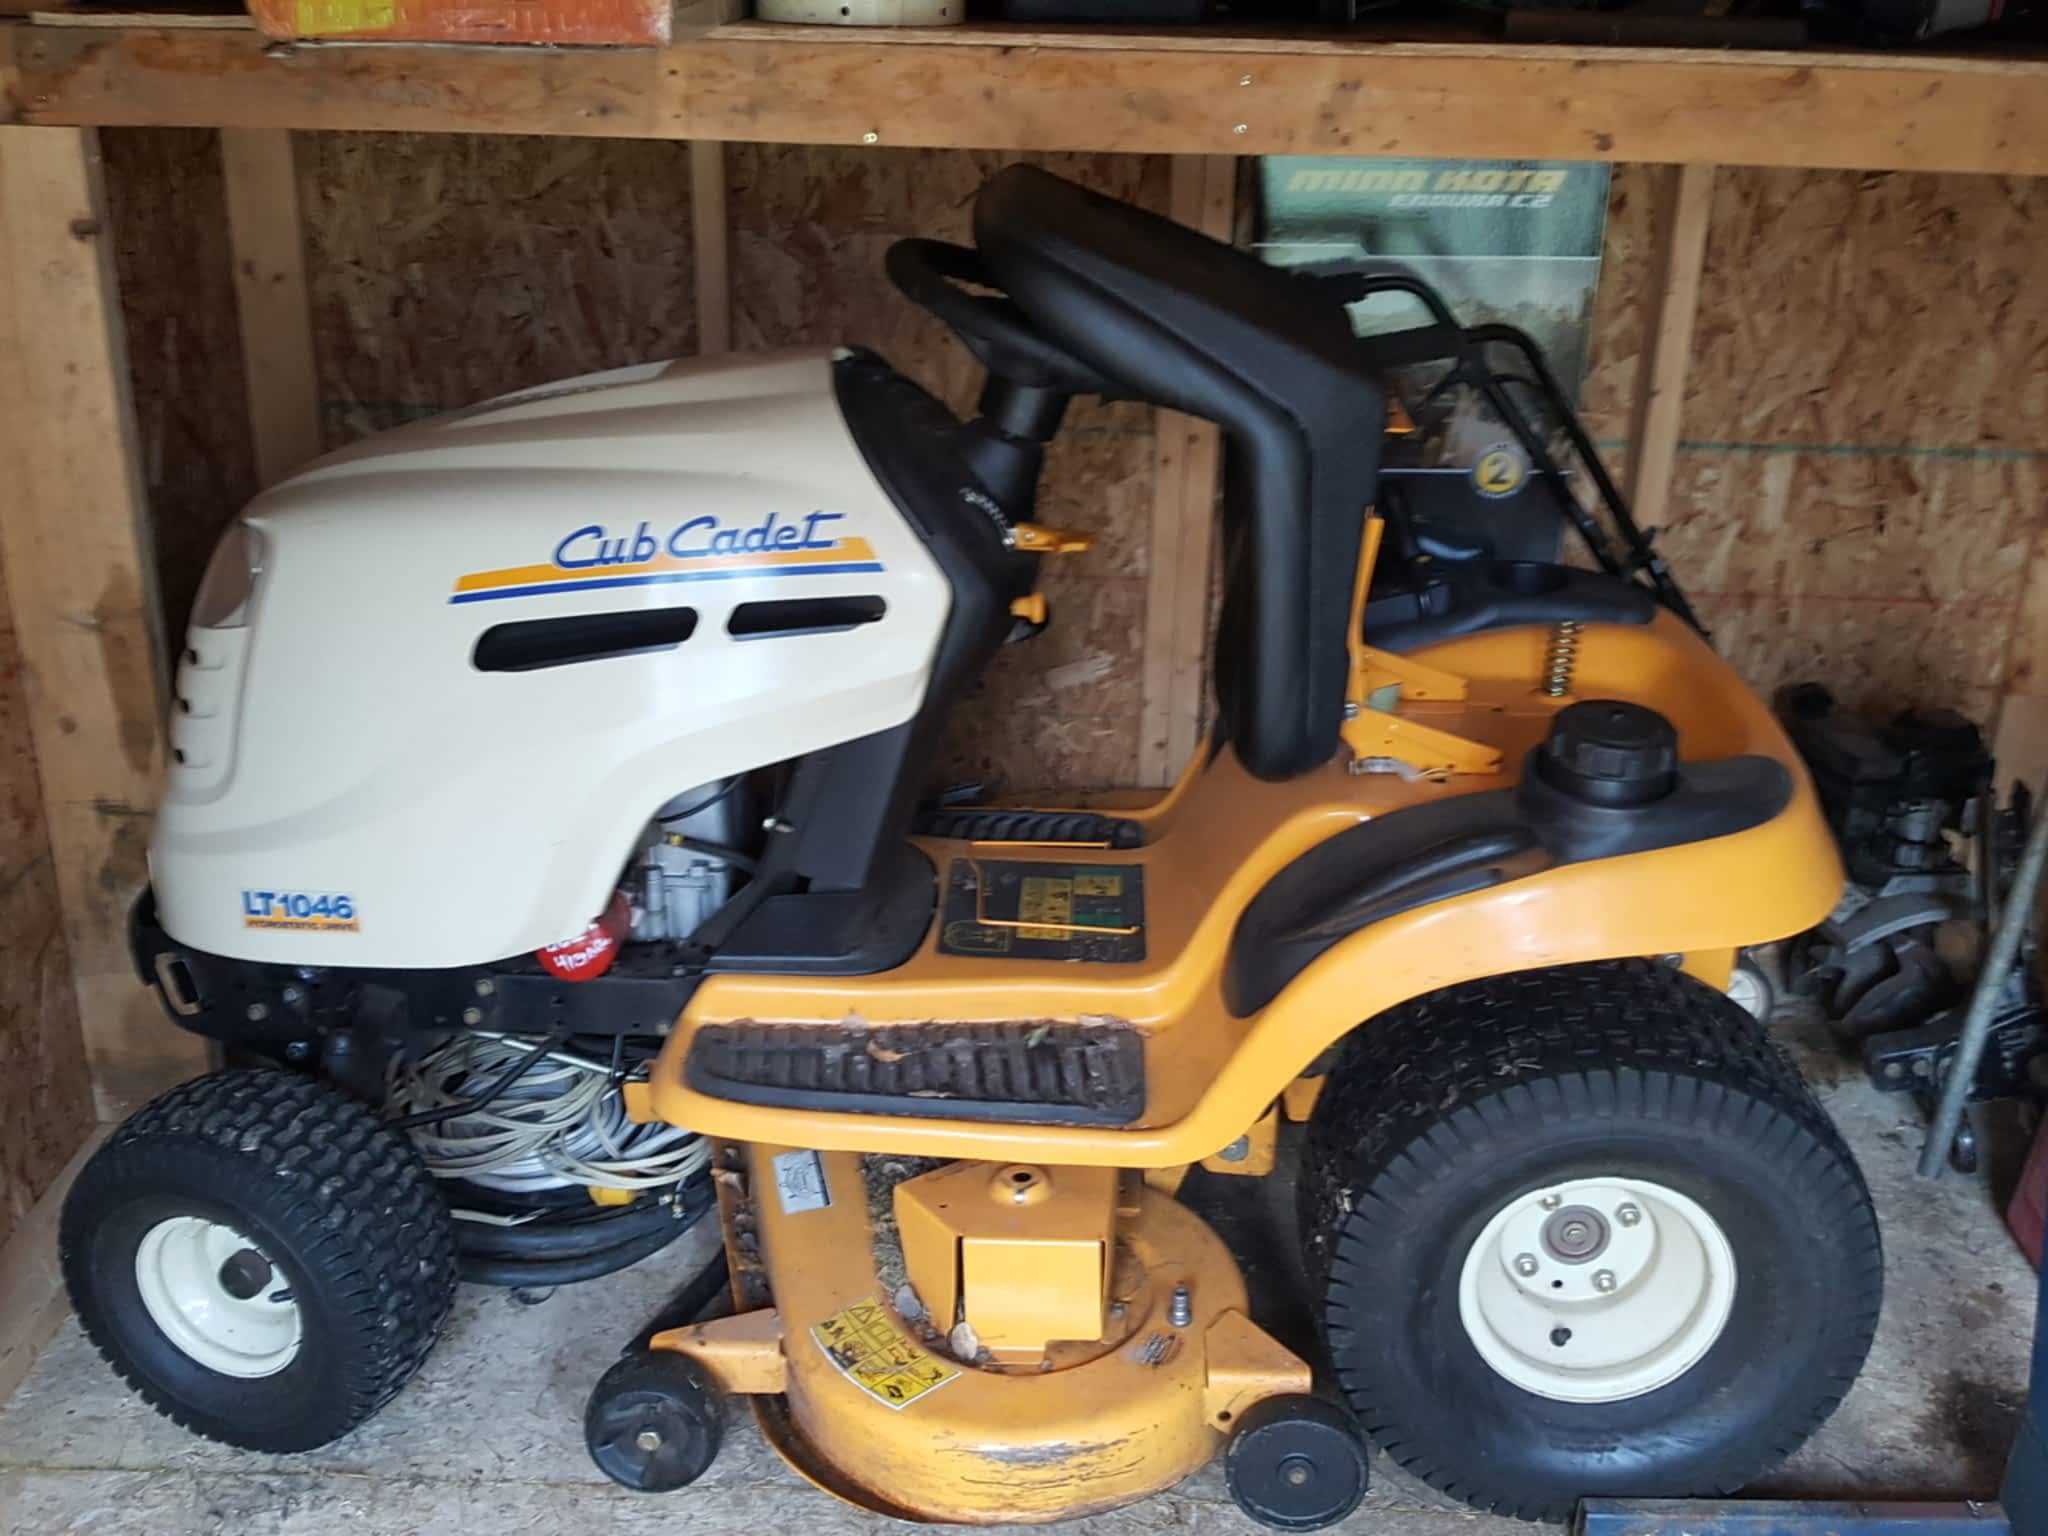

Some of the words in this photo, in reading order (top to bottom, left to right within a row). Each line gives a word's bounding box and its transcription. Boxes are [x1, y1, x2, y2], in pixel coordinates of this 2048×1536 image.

[1433, 170, 1568, 192] KOTA
[1488, 453, 1510, 485] 2
[554, 520, 659, 569] Cub
[666, 510, 846, 559] Cadet
[241, 890, 355, 919] LT1046
